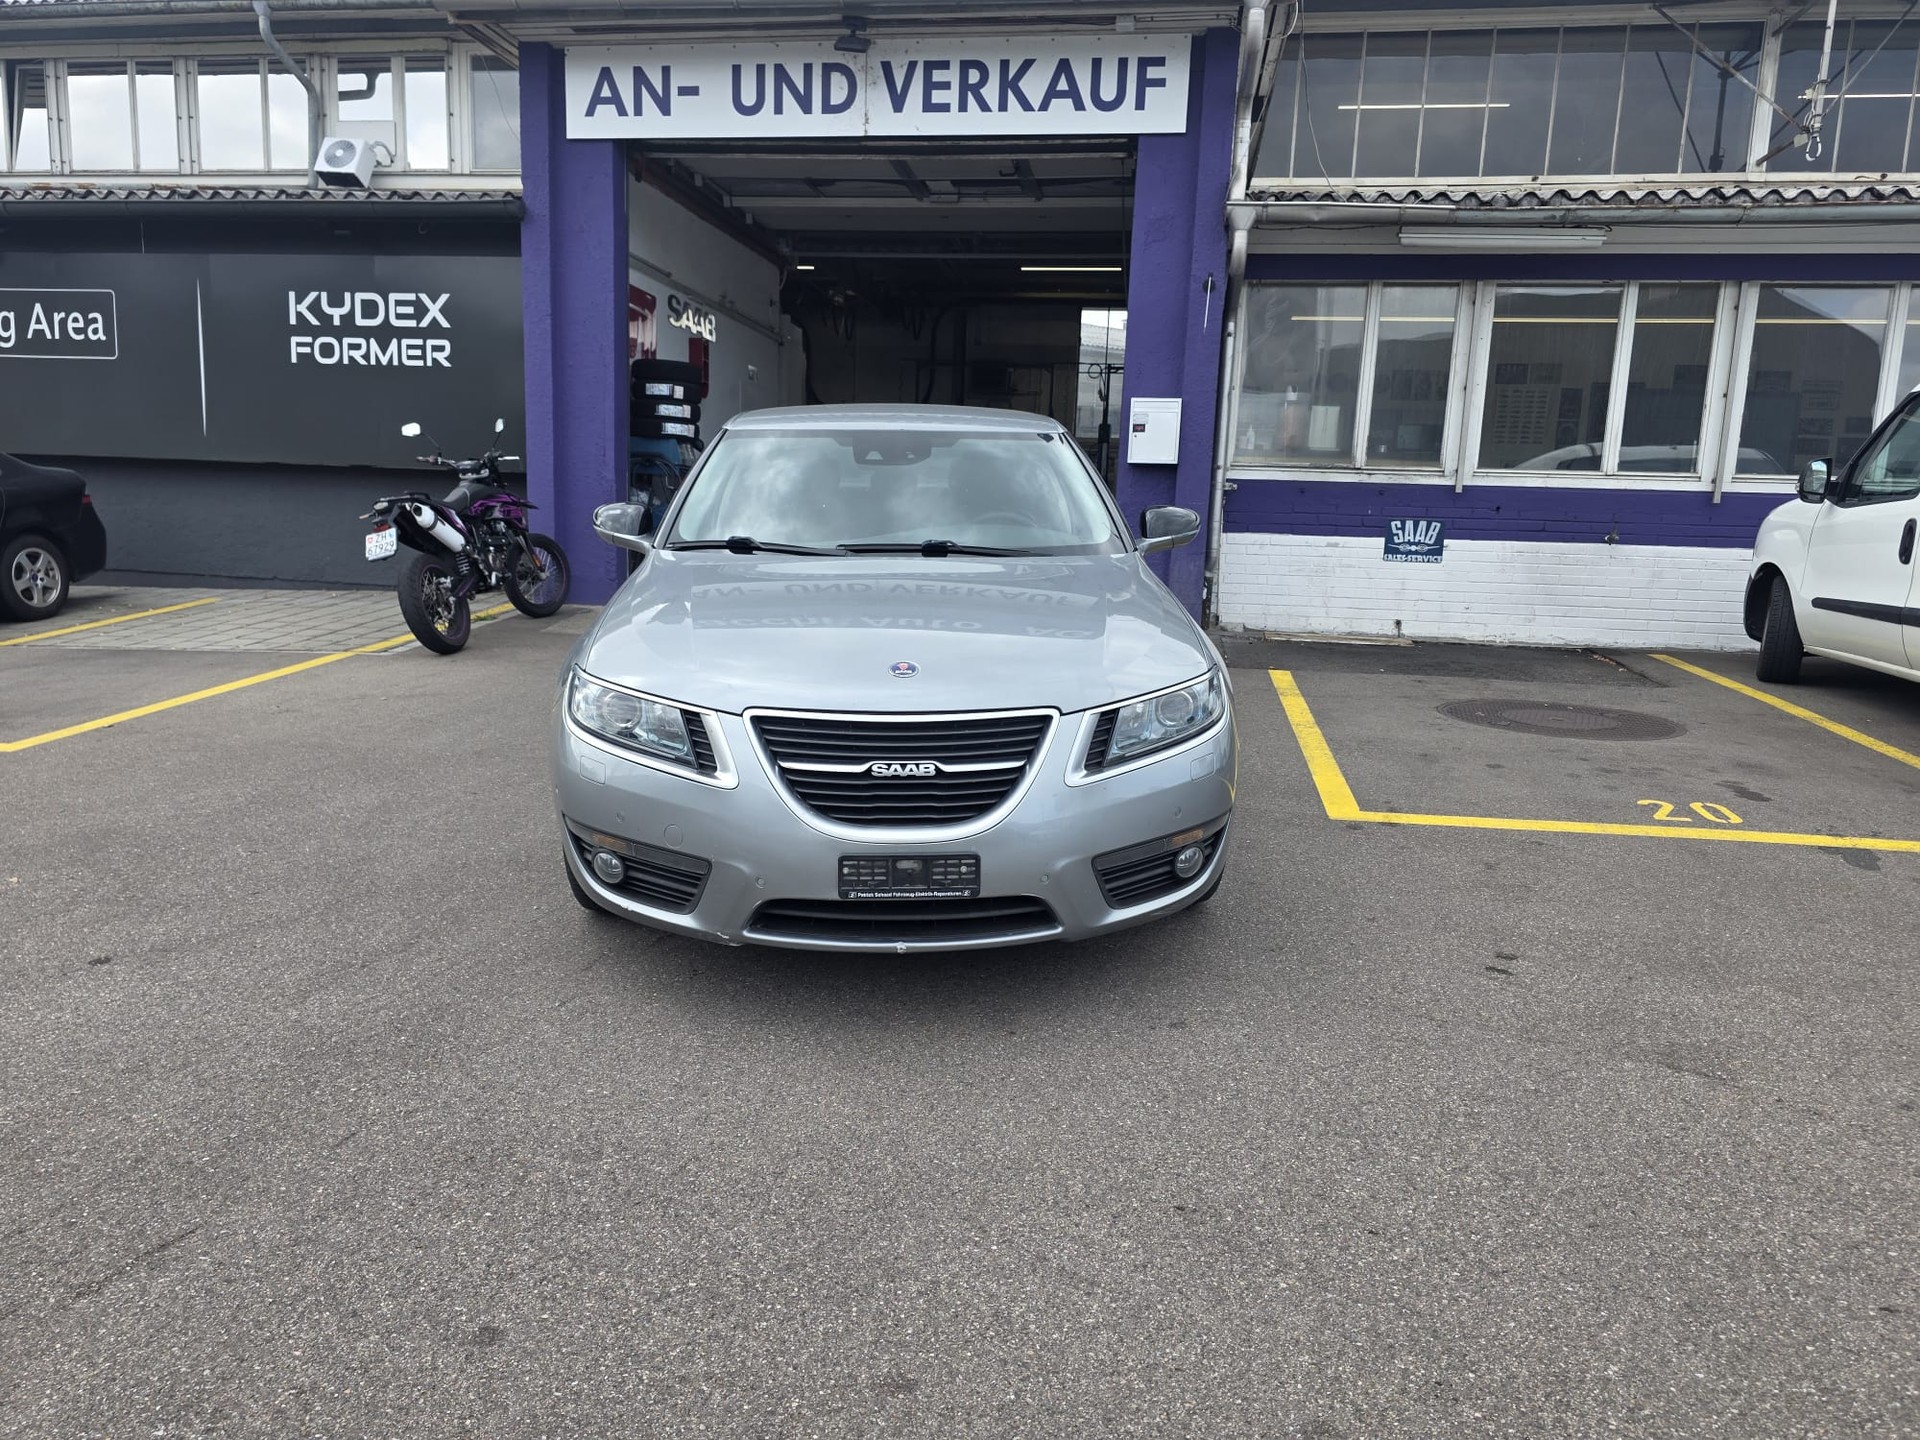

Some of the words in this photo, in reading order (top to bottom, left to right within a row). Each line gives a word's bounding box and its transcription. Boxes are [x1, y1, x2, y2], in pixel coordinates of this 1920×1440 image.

[584, 64, 701, 118] AN-
[731, 61, 858, 117] UND
[880, 55, 1167, 114] VERKAUF
[27, 302, 107, 341] Area
[288, 290, 452, 329] KYDEX
[668, 294, 717, 342] SAAB
[290, 335, 452, 368] FORMER
[375, 532, 387, 543] ZH
[1390, 519, 1441, 545] SAAB
[367, 540, 395, 556] 67929
[871, 763, 937, 777] SAAB
[1636, 798, 1744, 825] 20
